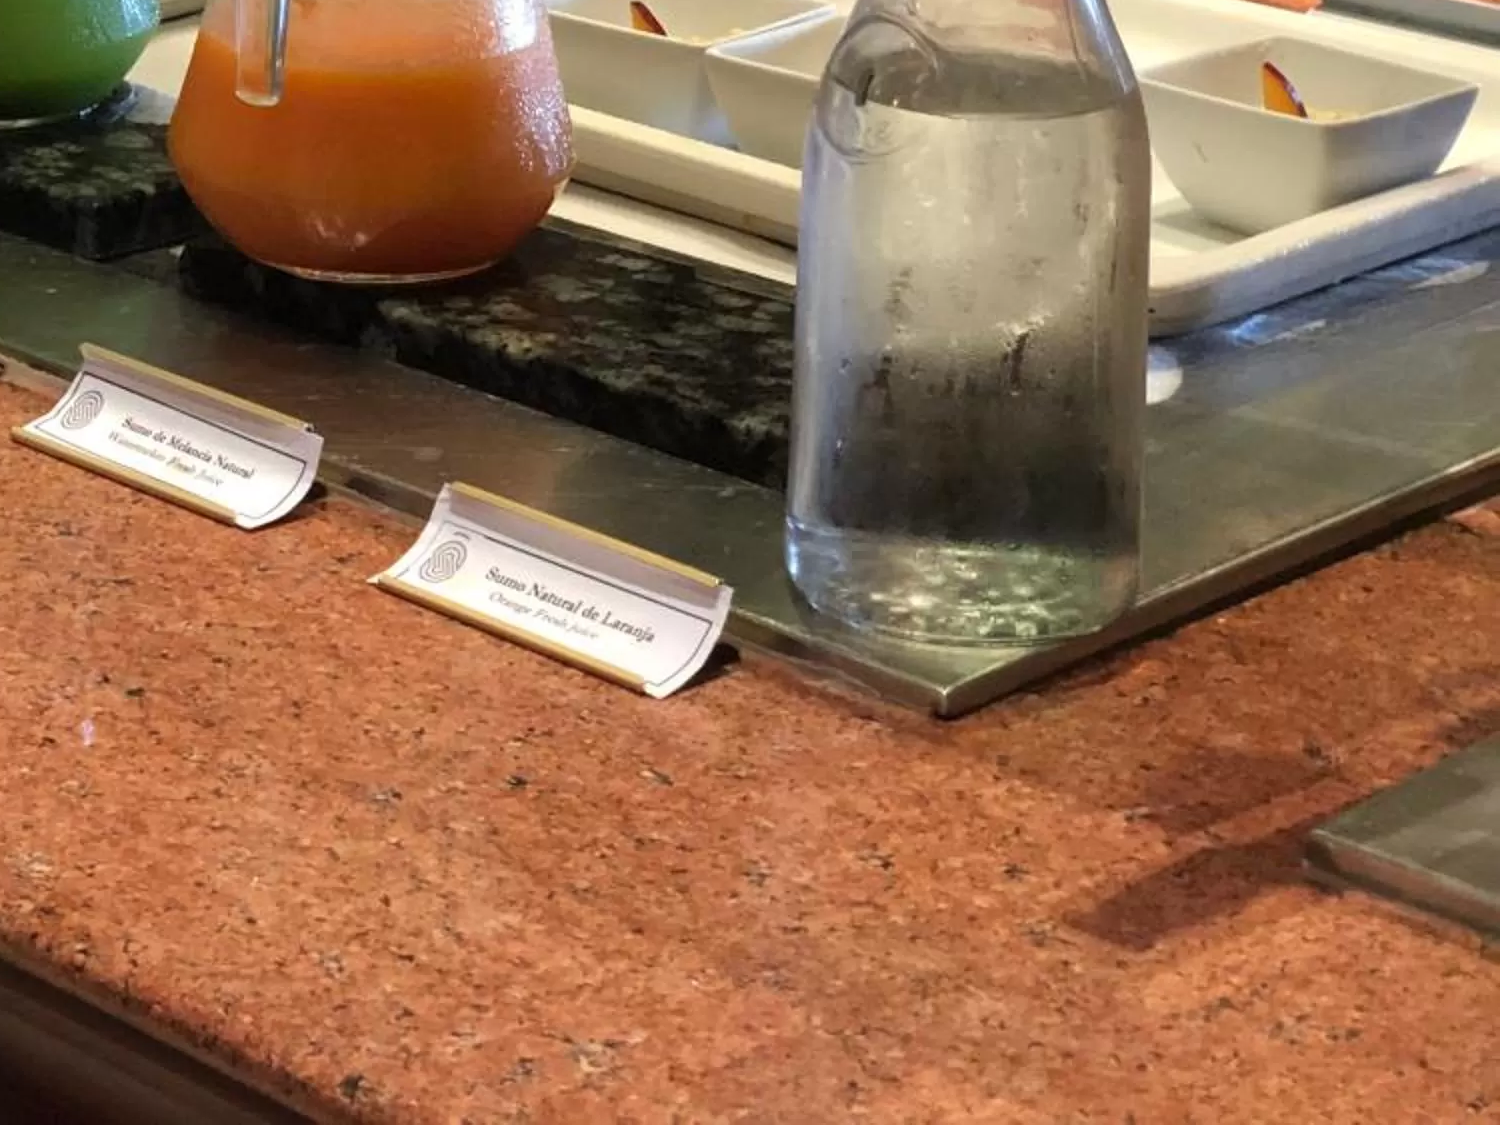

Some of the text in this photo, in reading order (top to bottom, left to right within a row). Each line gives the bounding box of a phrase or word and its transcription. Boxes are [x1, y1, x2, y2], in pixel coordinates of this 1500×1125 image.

[122, 416, 256, 480] Sumo de Melancia Natural
[485, 565, 656, 643] Sumo Natural de Laranja
